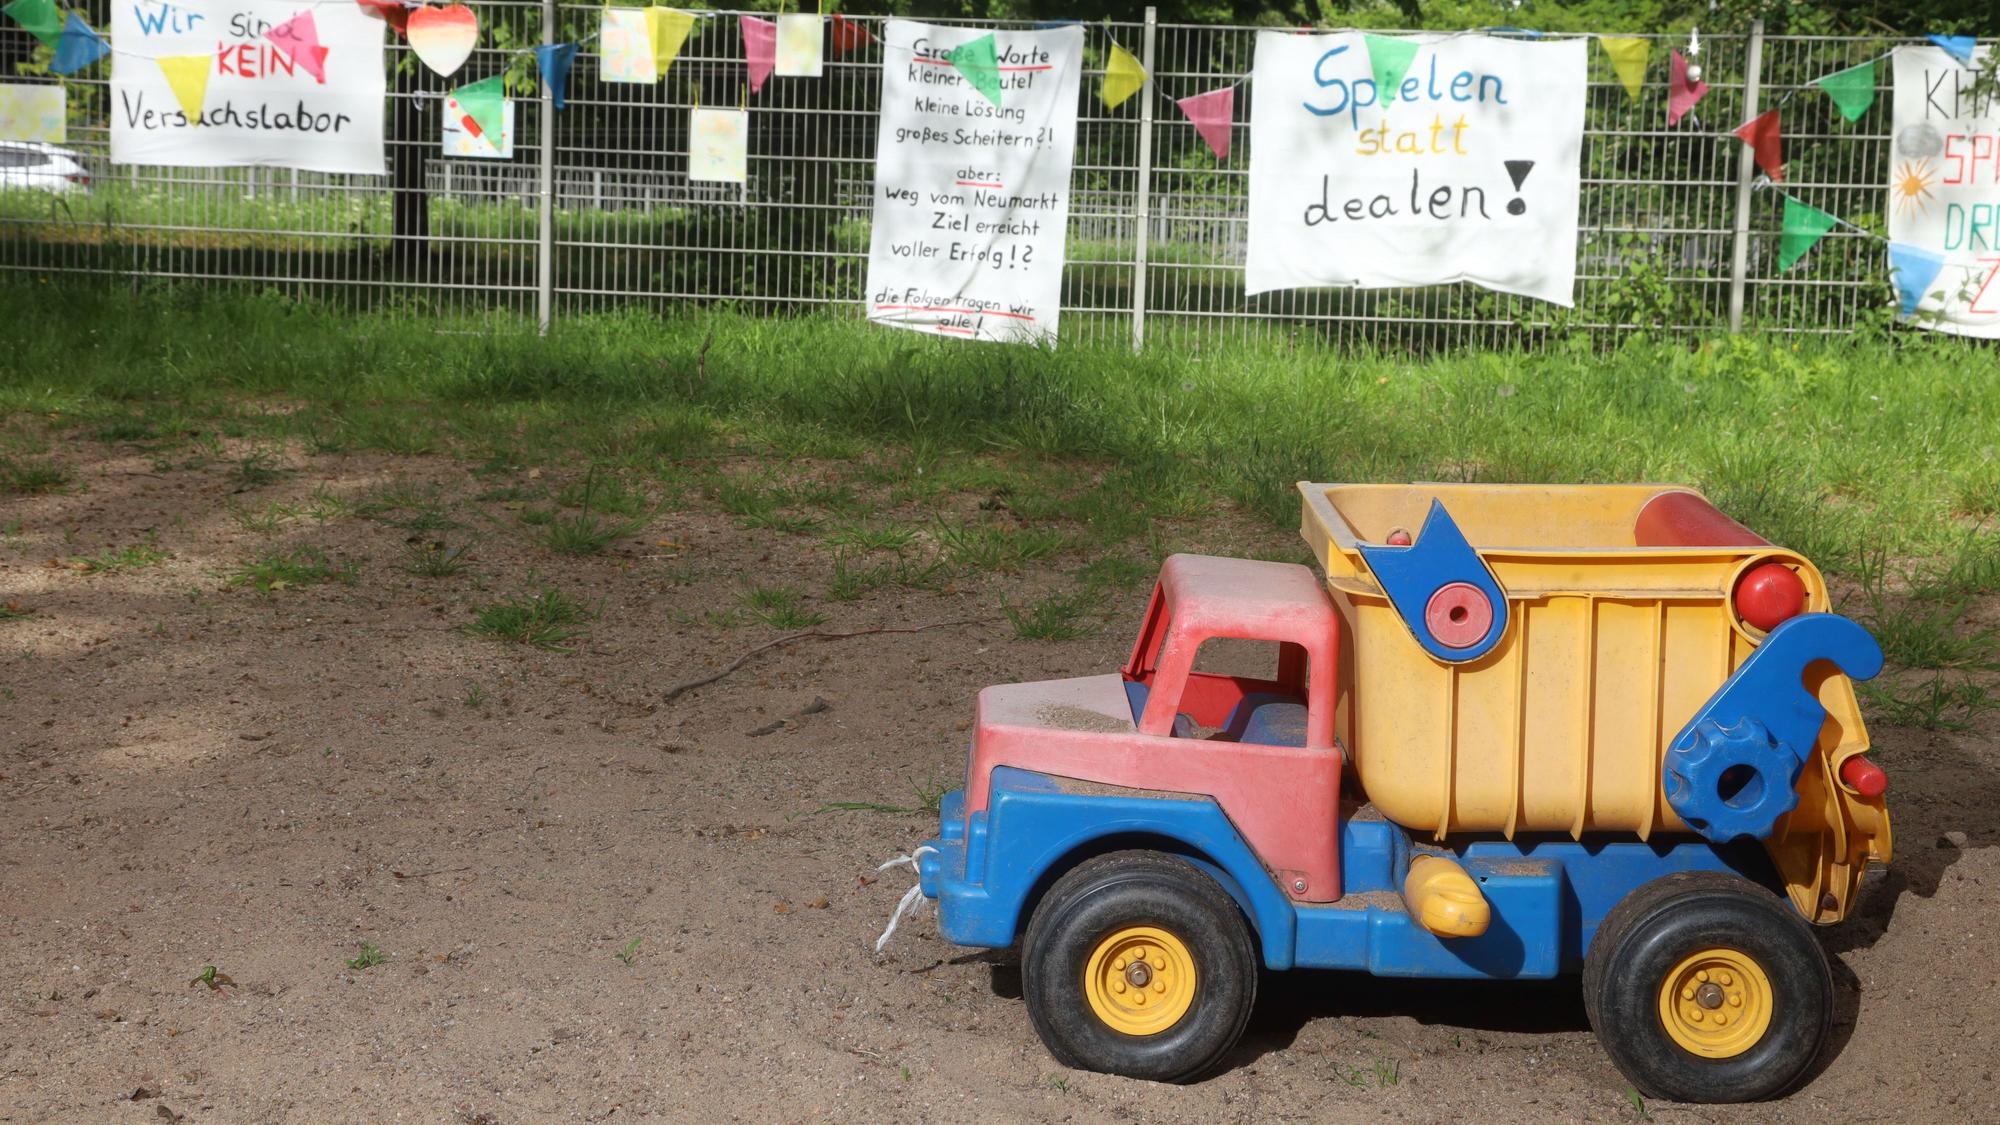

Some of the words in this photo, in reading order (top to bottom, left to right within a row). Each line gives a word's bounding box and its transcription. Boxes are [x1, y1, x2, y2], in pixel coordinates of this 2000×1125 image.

[133, 3, 206, 36] Wir
[228, 10, 304, 42] sind
[912, 38, 977, 62] Große
[988, 44, 1050, 65] Worte
[908, 63, 964, 87] kleiner
[1302, 45, 1508, 131] Spielen
[121, 88, 351, 133] Versuchslabor
[914, 97, 960, 116] kleine
[966, 99, 1026, 124] Lösung
[895, 126, 949, 145] großes
[1355, 112, 1470, 156] statt
[956, 165, 1001, 182] aber:
[929, 192, 965, 205] vom
[973, 189, 1059, 211] Neumarkt
[1303, 159, 1536, 227] dealen!
[931, 211, 969, 232] Ziel
[975, 217, 1041, 236] erreicht
[891, 240, 940, 258] voller
[875, 286, 899, 304] die
[904, 287, 951, 309] Folgen
[953, 290, 1001, 314] tragen
[1009, 298, 1036, 316] wir
